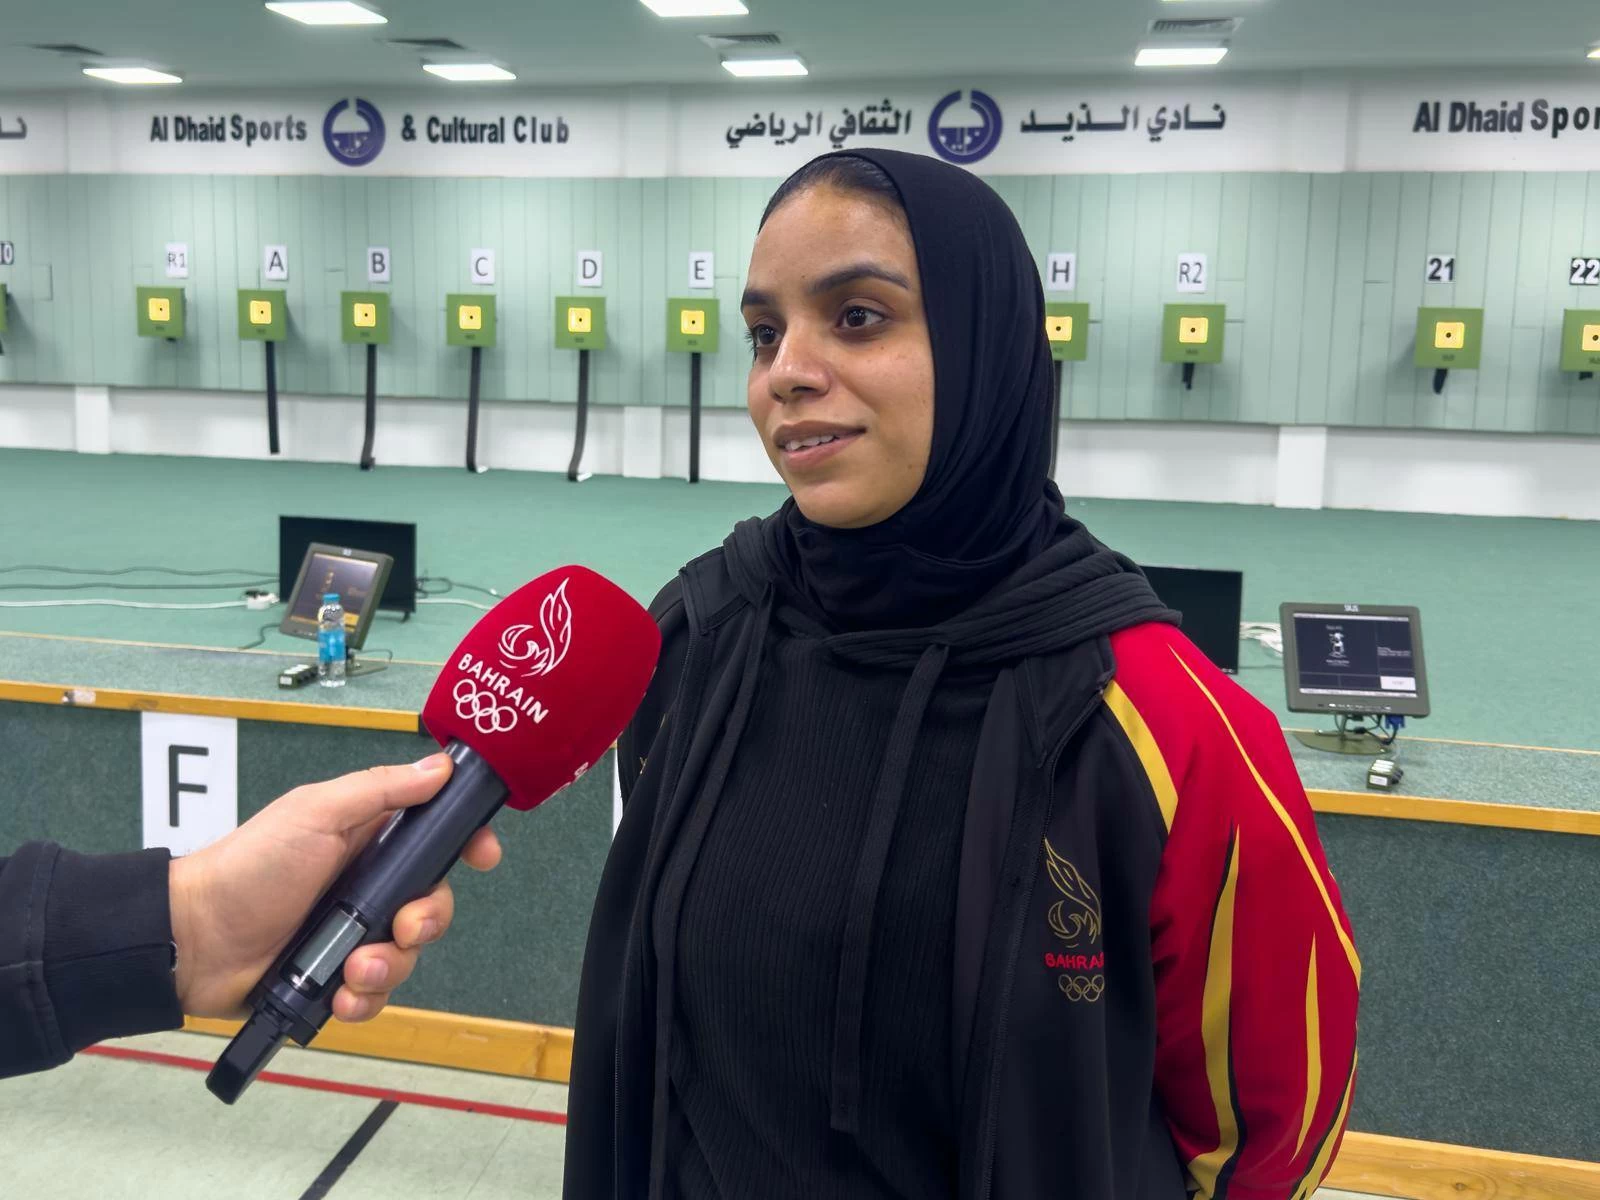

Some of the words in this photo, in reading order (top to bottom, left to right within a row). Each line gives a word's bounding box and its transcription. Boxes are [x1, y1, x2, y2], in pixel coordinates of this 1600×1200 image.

[726, 110, 823, 148] الرياضي
[829, 97, 912, 149] الثقافي
[1020, 102, 1140, 142] الذيد
[1147, 103, 1226, 142] نادي
[1412, 101, 1441, 133] Al
[1448, 101, 1525, 133] Dhaid
[1530, 98, 1600, 139] Spor
[150, 115, 169, 142] Al
[174, 115, 226, 142] Dhaid
[230, 113, 308, 148] Sports
[401, 113, 417, 142] &
[427, 115, 505, 144] Cultural
[513, 115, 570, 144] Club
[0, 242, 14, 264] 0
[167, 252, 186, 269] R1
[269, 250, 284, 272] A
[371, 252, 386, 274] B
[475, 257, 489, 277] C
[582, 258, 598, 280] D
[694, 259, 706, 280] E
[1051, 260, 1070, 283] H
[1178, 262, 1203, 284] R2
[1428, 257, 1455, 281] 21
[1570, 258, 1600, 284] 22
[458, 653, 549, 724] BAHRAIN
[168, 744, 209, 828] F
[1045, 952, 1104, 970] BAHRAI
